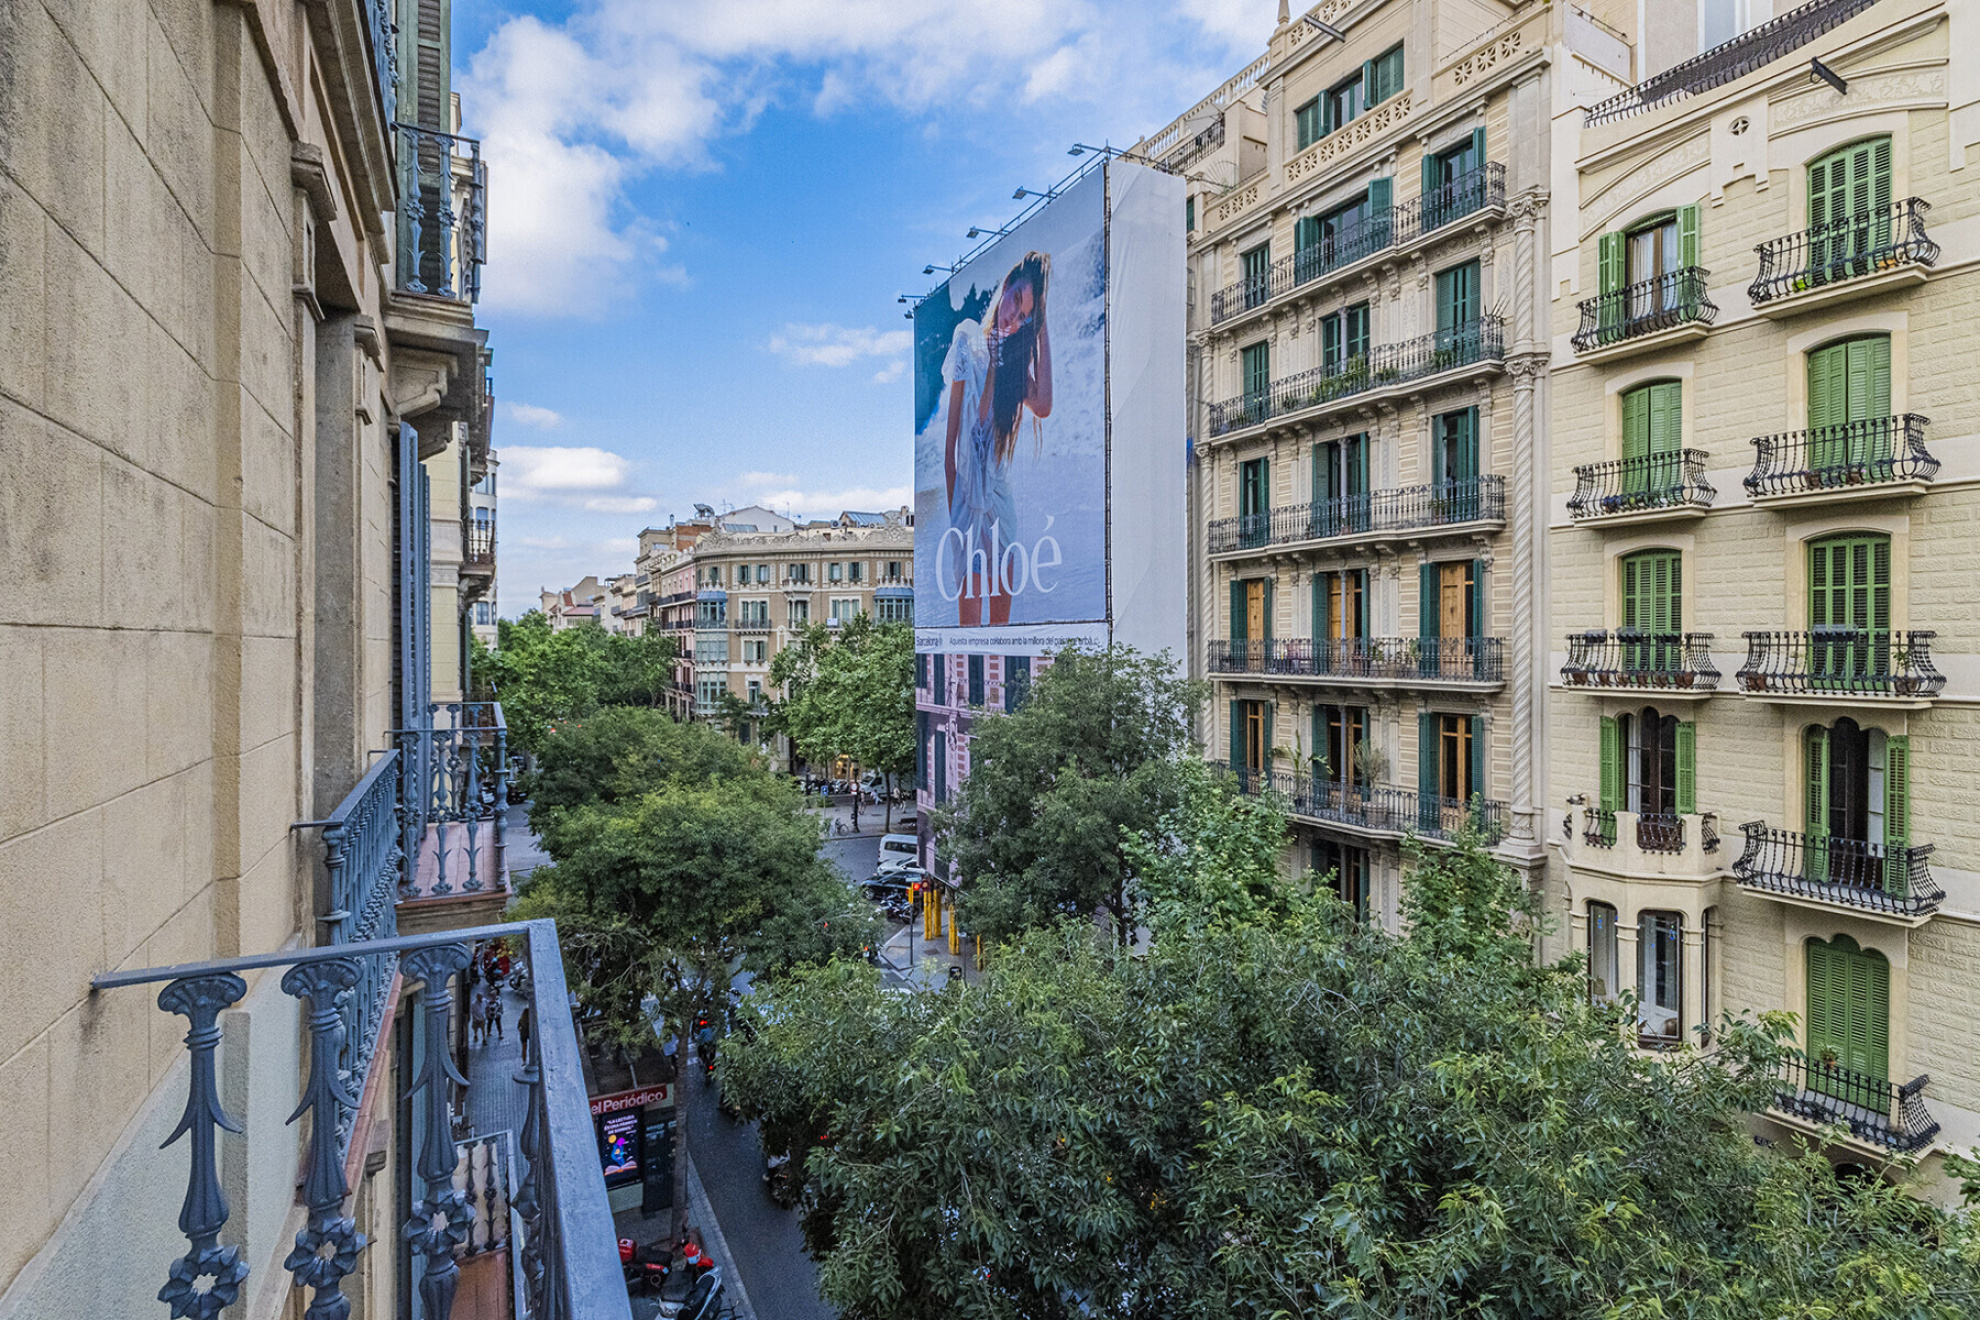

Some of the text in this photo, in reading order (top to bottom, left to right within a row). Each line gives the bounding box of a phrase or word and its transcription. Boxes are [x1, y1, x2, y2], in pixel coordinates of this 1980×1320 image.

[935, 515, 1063, 602] Chloé
[591, 1091, 664, 1115] el Periódico
